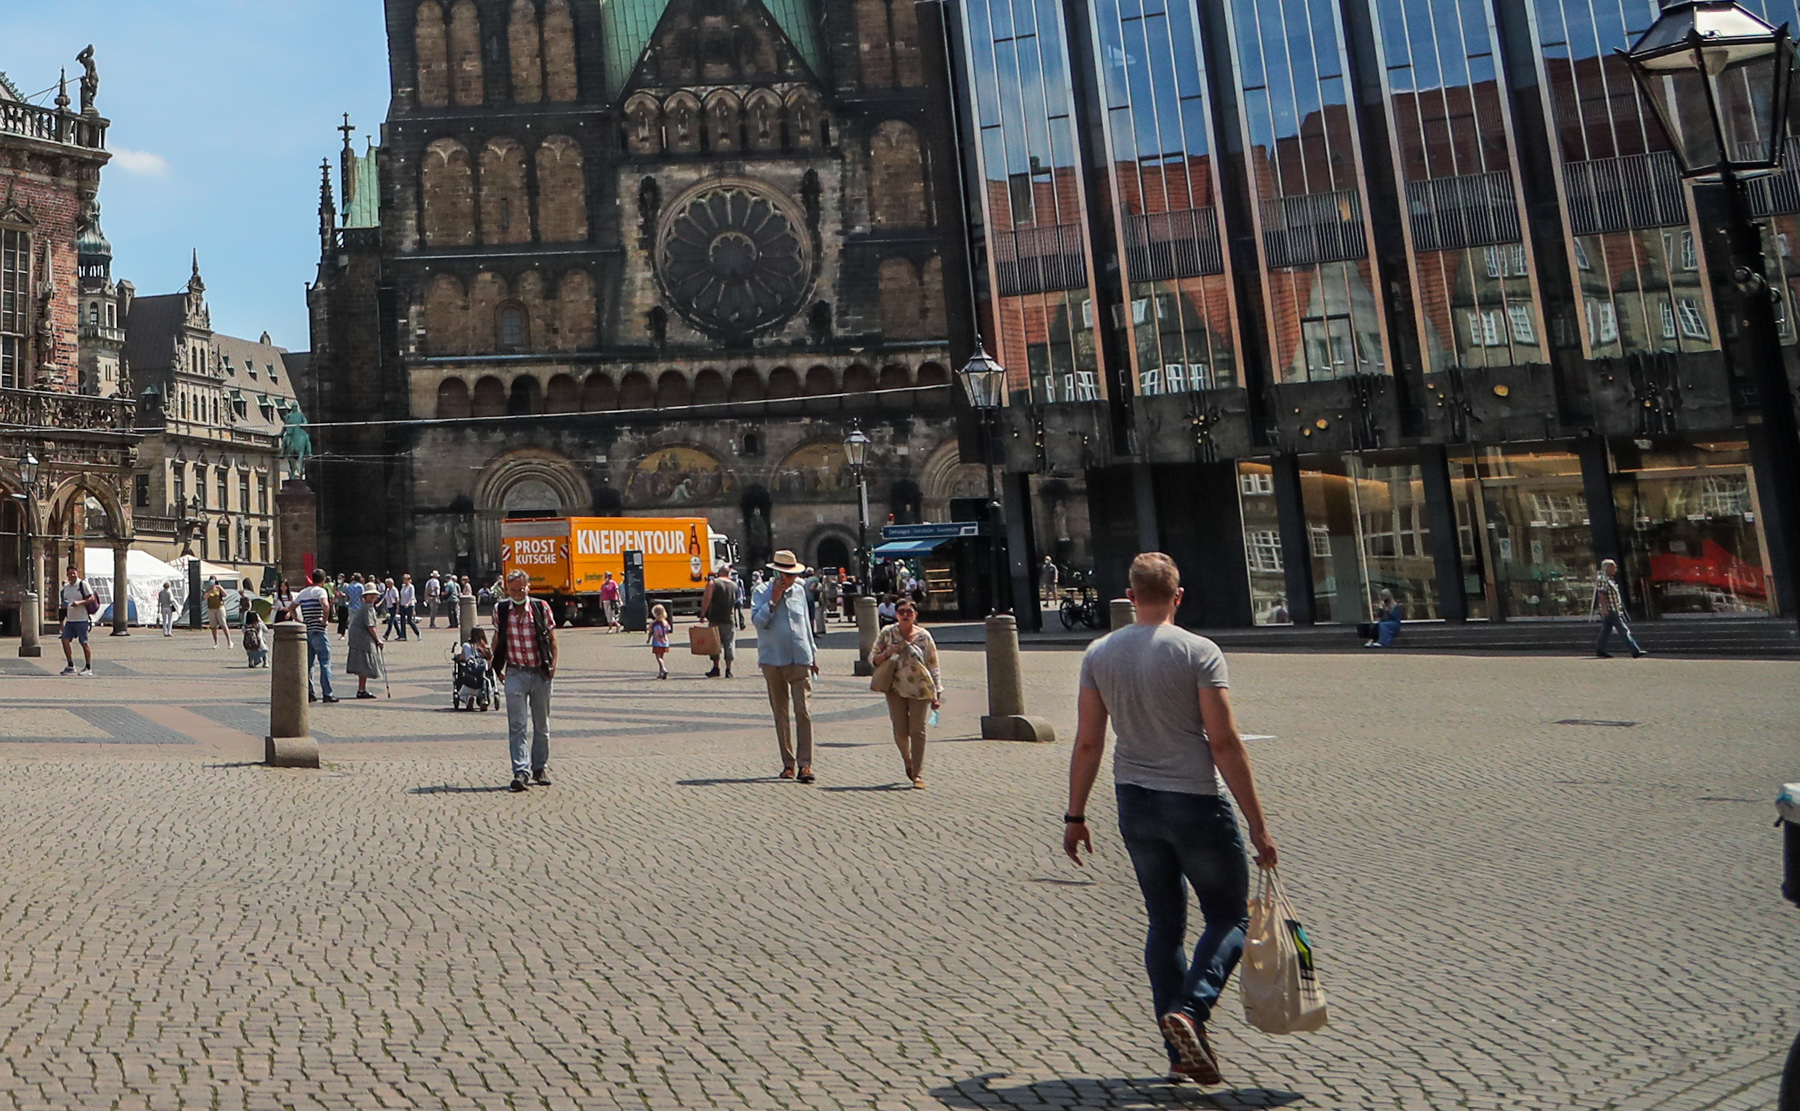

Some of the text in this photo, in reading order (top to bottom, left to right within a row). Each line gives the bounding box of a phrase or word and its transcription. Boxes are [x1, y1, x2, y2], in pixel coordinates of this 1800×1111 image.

[515, 540, 556, 554] PROST
[577, 530, 686, 555] KNEIPENTOUR
[516, 554, 557, 565] KUTSCHE
